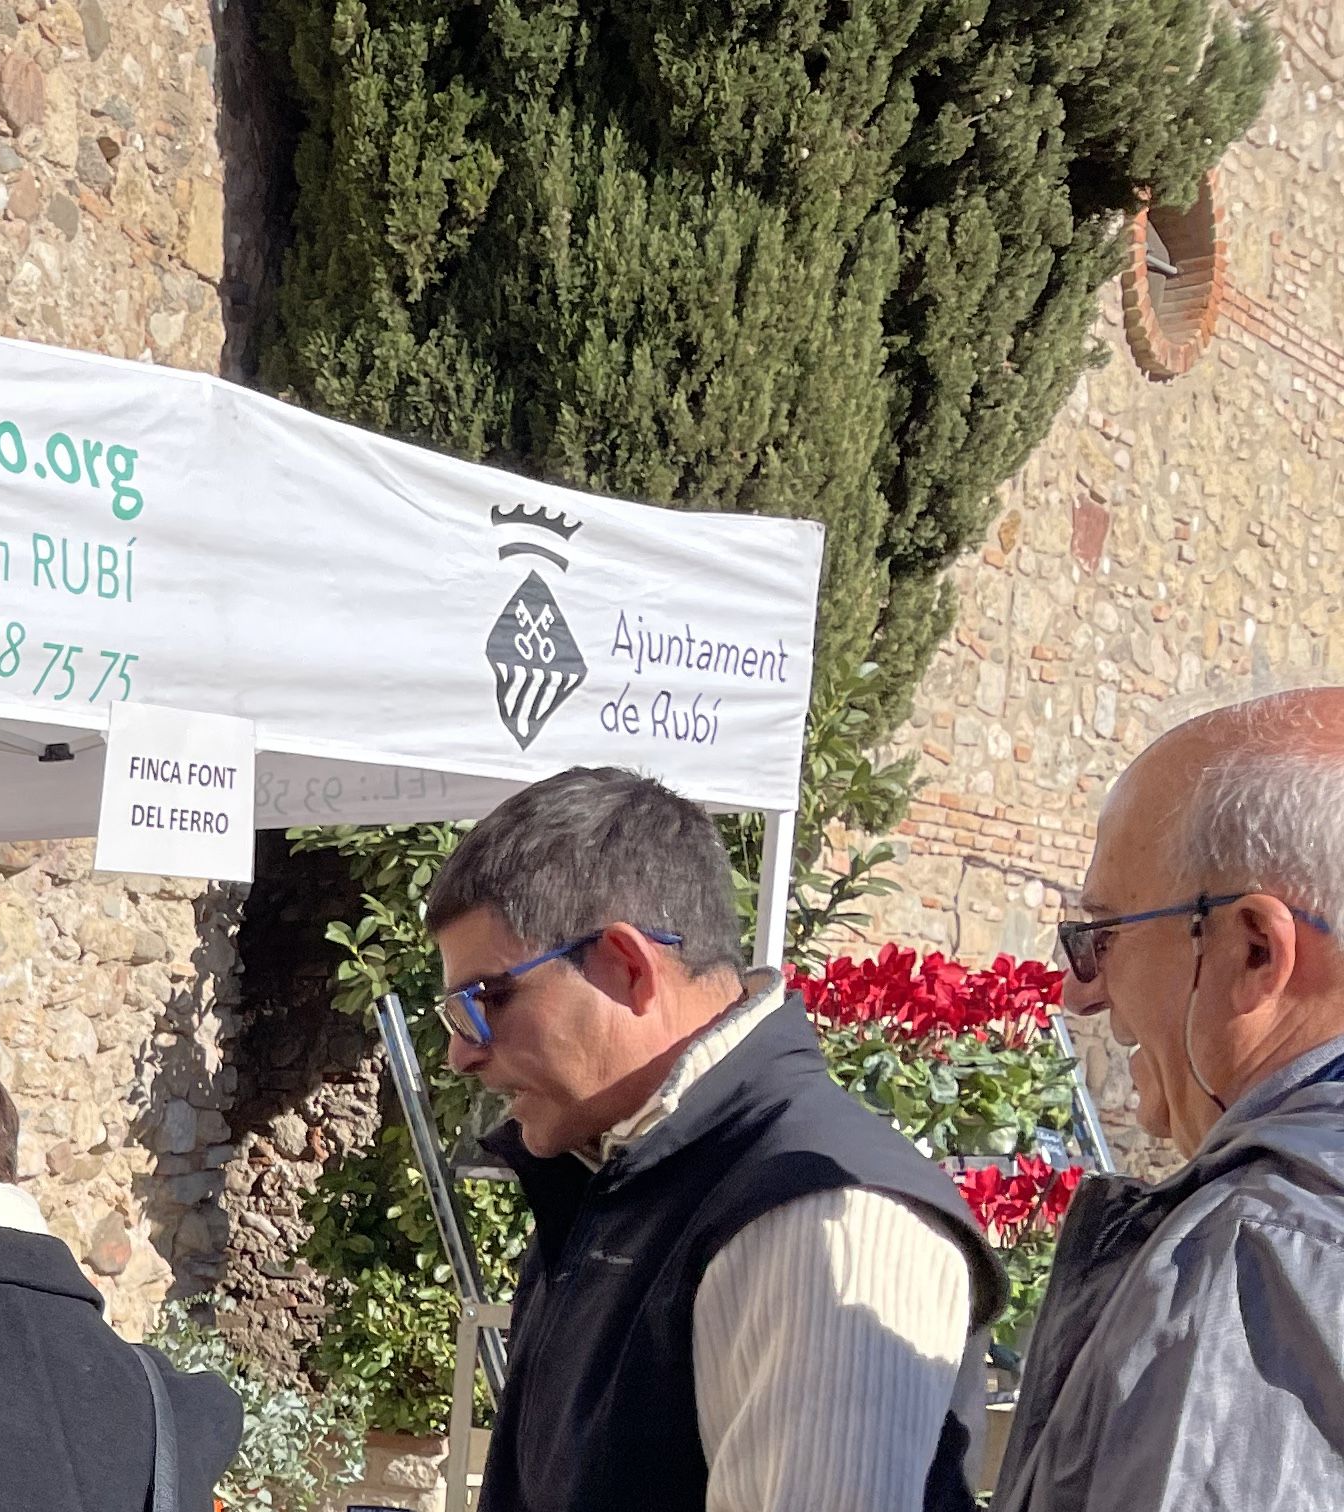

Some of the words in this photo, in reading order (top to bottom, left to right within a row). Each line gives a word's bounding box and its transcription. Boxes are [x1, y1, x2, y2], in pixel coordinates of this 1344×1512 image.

[32, 537, 136, 603] RUBÍ
[33, 641, 85, 701] 75
[88, 650, 141, 703] 75
[611, 608, 789, 684] Ajuntament
[600, 672, 641, 735] de
[652, 690, 723, 746] Rubí
[129, 756, 182, 785] FINCA
[187, 762, 237, 790] FONT
[131, 803, 165, 829] DEL
[169, 808, 230, 835] FERRO
